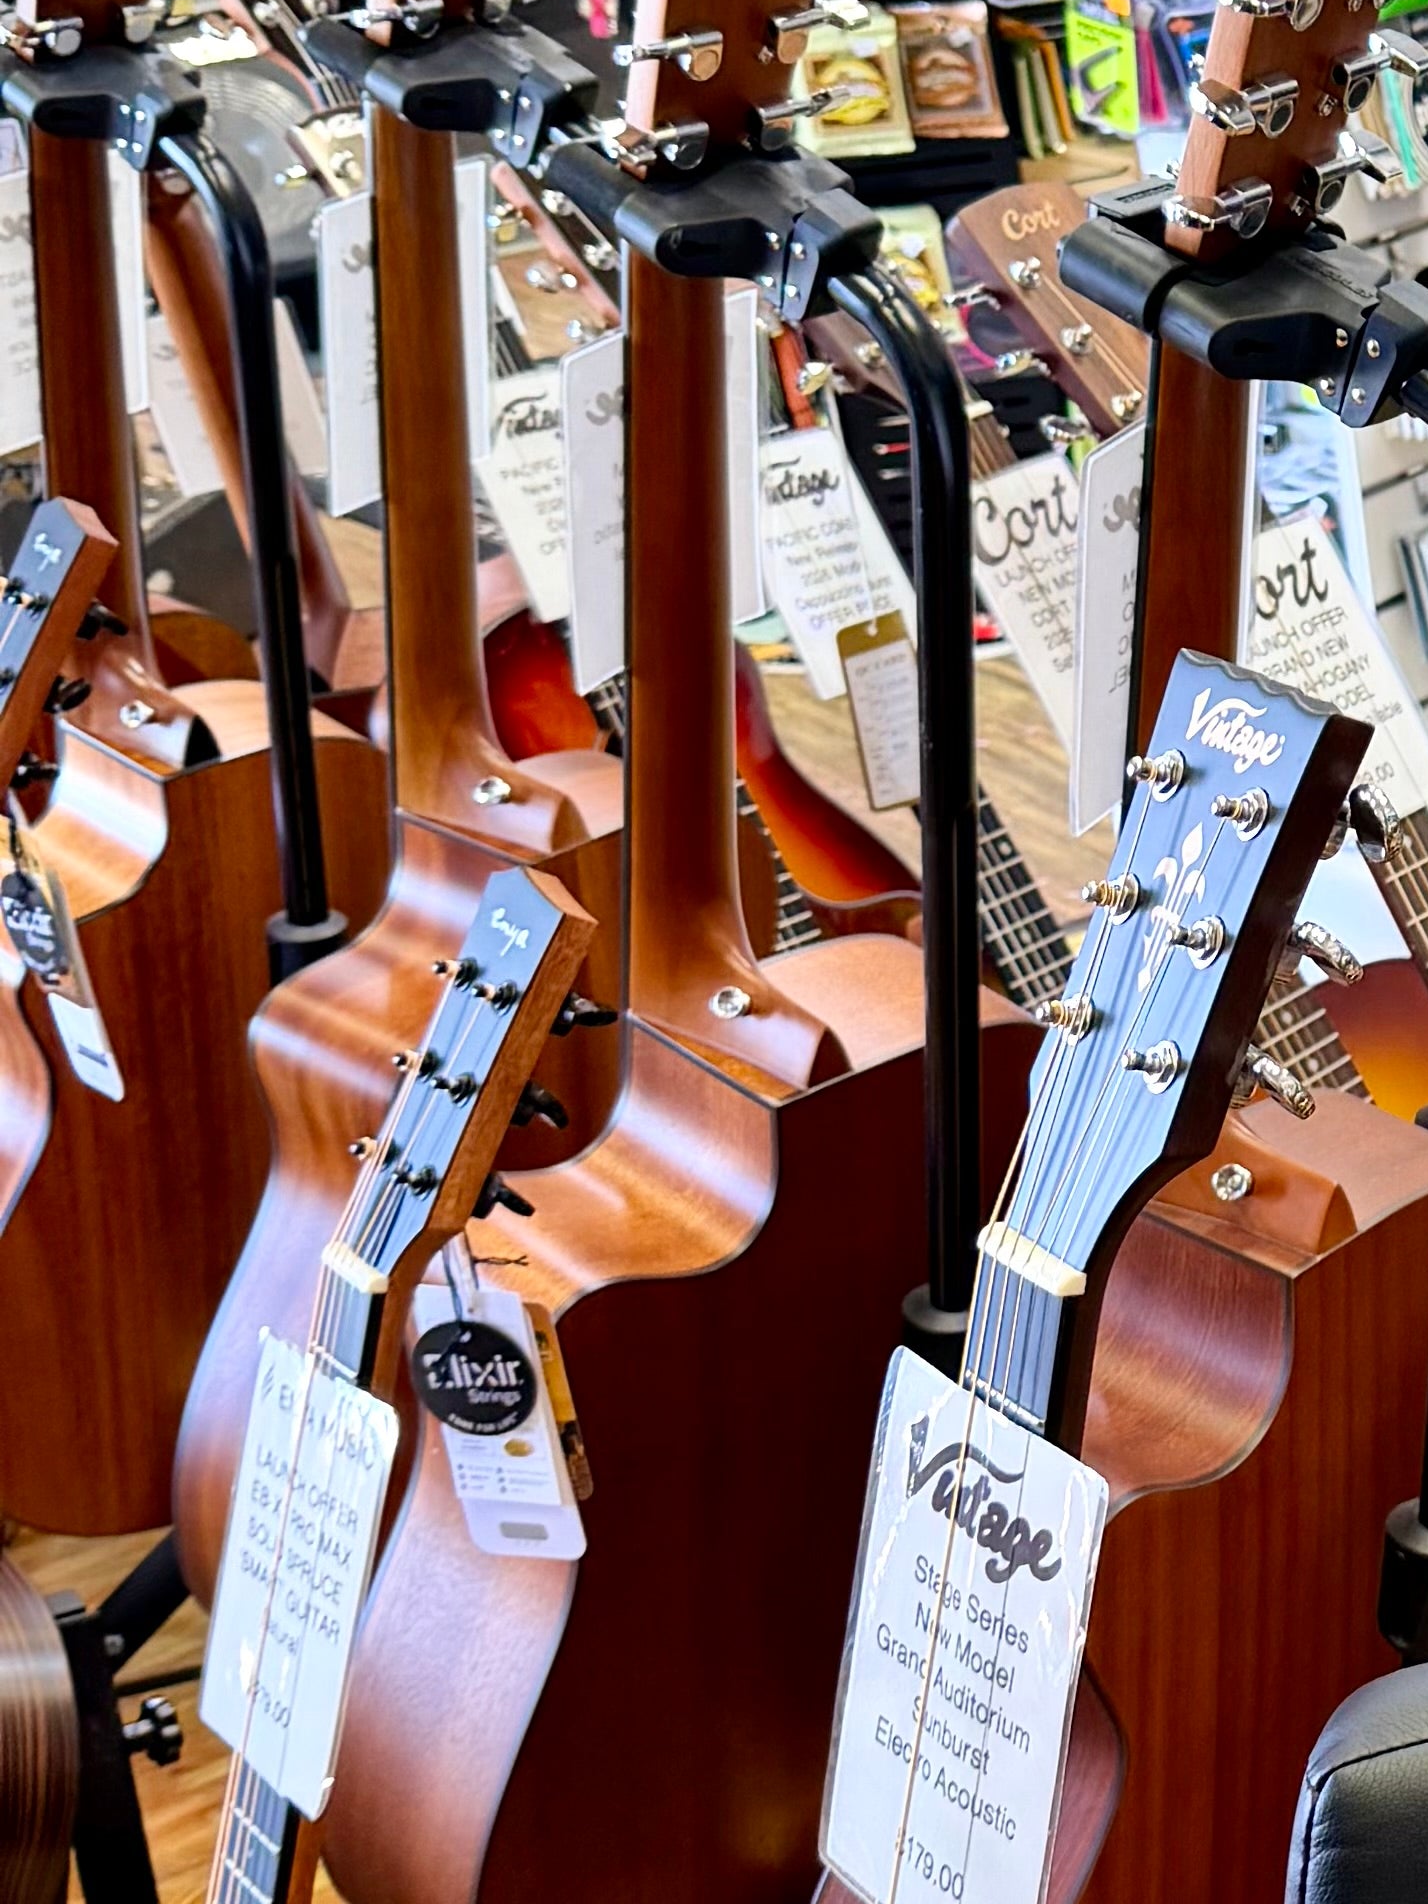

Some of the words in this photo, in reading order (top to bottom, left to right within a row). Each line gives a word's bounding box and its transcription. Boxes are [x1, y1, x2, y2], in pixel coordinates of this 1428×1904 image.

[1001, 202, 1062, 241] Cort
[975, 475, 1078, 566] Cort
[1256, 536, 1329, 620] ort
[1300, 606, 1347, 637] OFFER
[1316, 634, 1349, 658] NEW
[1302, 653, 1370, 693] AHOGANY
[1332, 682, 1376, 710] ODEL
[1185, 686, 1286, 774] Vintage
[422, 1352, 525, 1390] Elixir
[966, 1593, 1030, 1655] Series
[954, 1632, 1017, 1694] Model
[932, 1665, 1032, 1755] Auditorium
[874, 1714, 932, 1782] Elecro
[933, 1766, 1018, 1842] Acoustic
